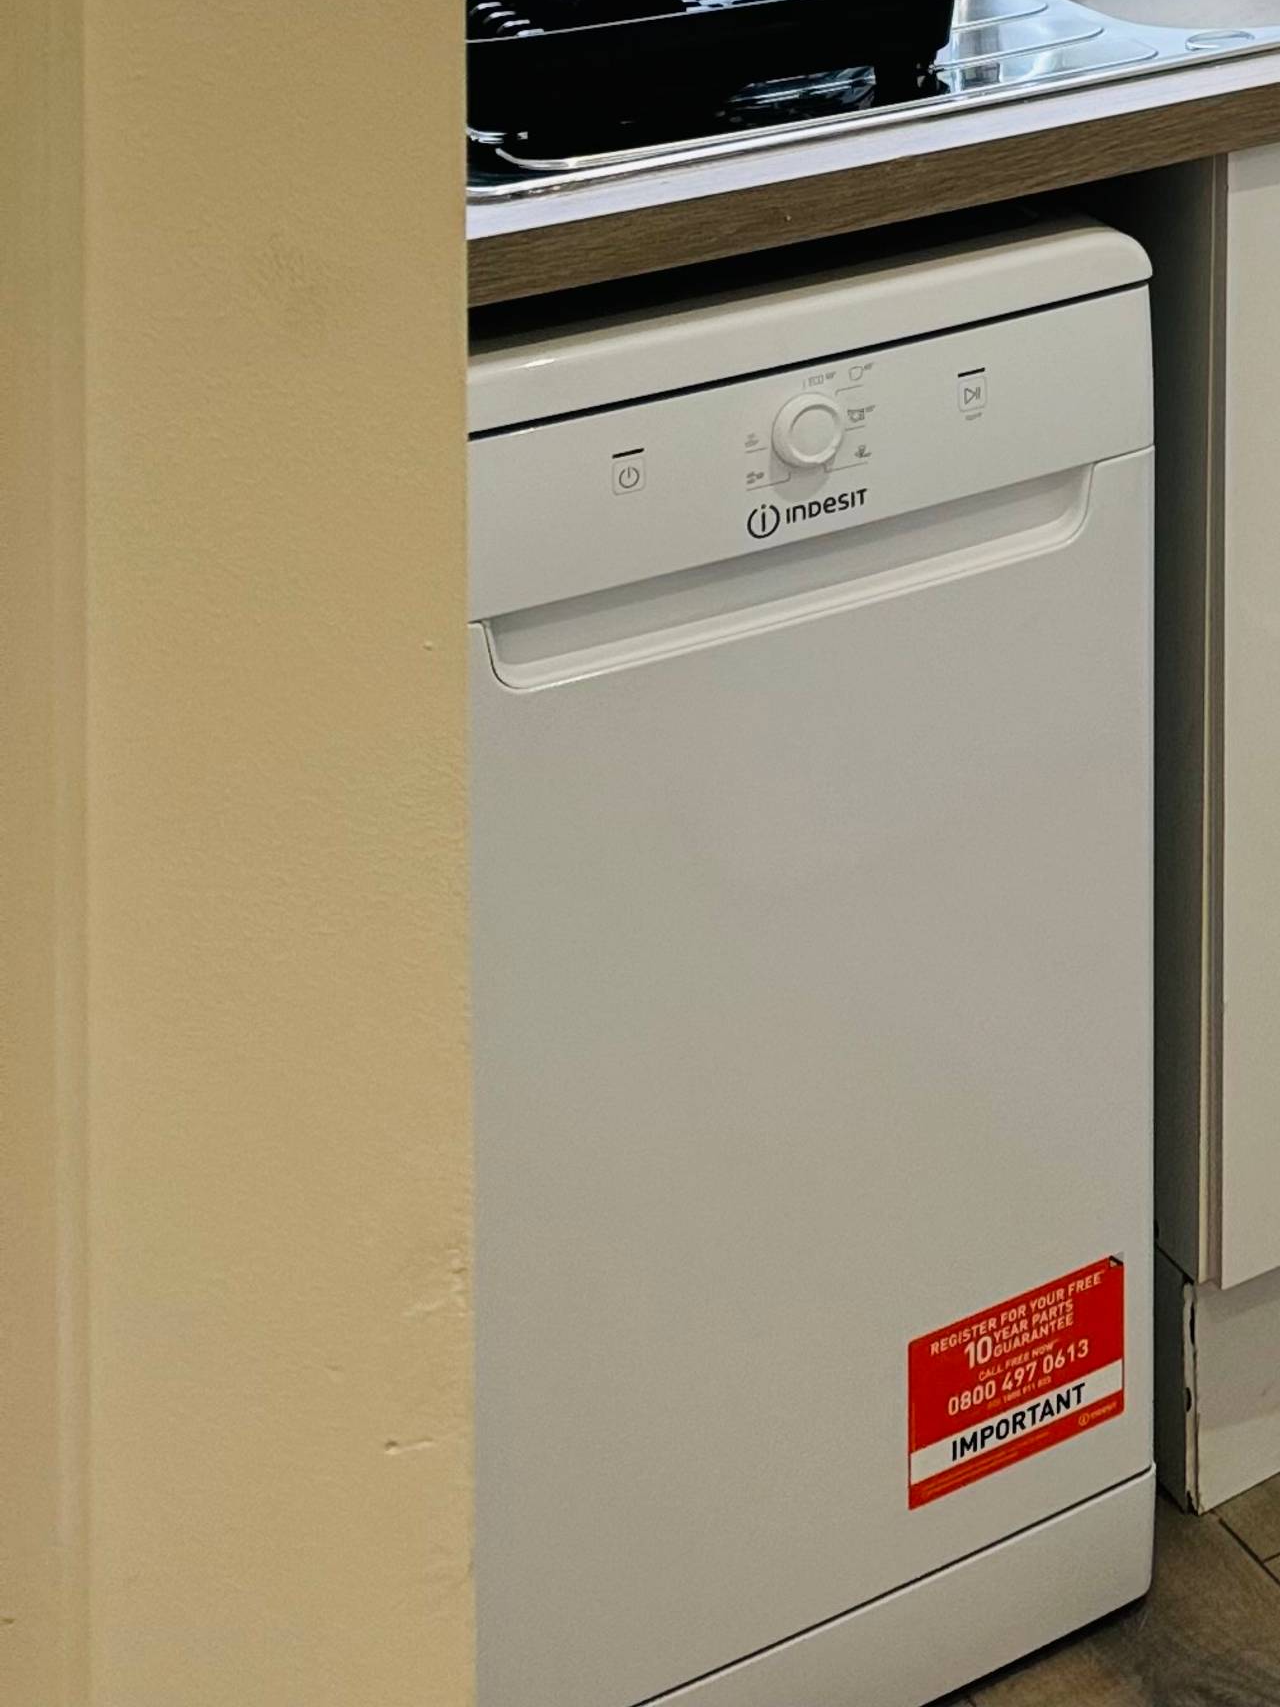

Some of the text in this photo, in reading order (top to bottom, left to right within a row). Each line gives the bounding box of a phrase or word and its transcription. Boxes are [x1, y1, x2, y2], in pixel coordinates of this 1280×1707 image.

[930, 1314, 997, 1356] REGISTER
[1000, 1305, 1026, 1325] FOR
[1030, 1289, 1065, 1312] YOUR
[993, 1298, 1073, 1342] YEAR PARTS
[993, 1313, 1074, 1358] GUARANTEE
[964, 1335, 993, 1370] 10
[978, 1364, 1003, 1381] CALL
[1005, 1352, 1030, 1368] FREE
[948, 1380, 996, 1416] 0800
[1001, 1362, 1037, 1391] 497
[1042, 1339, 1089, 1373] 0613
[951, 1382, 1086, 1462] IMPORTANT
